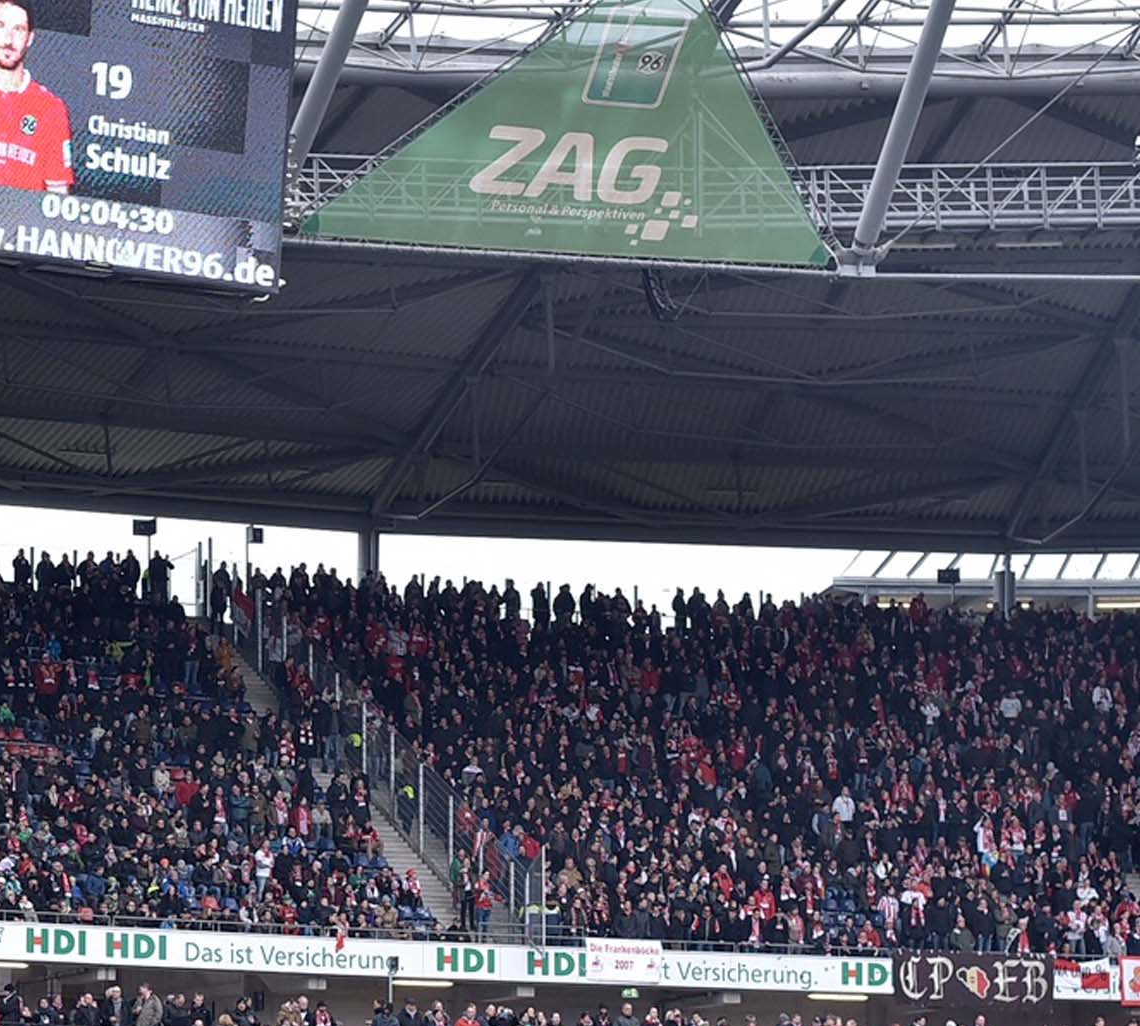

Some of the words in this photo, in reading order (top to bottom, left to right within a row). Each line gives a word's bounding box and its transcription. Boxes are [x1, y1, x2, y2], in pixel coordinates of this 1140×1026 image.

[224, 0, 284, 32] HEIDEN
[637, 53, 666, 73] 96
[91, 61, 133, 99] 19
[88, 114, 170, 146] Christian
[85, 148, 171, 180] Schulz
[469, 125, 669, 205] ZAG
[42, 194, 173, 235] 00:04:30
[490, 200, 547, 215] Personal
[561, 206, 647, 221] Perspektiven
[25, 927, 86, 956] HDI
[105, 931, 167, 960] HDI
[185, 941, 222, 964] Das
[229, 942, 253, 965] ist
[436, 947, 495, 973] HDI
[527, 951, 587, 977] HDI
[677, 961, 818, 989] Versicherung.
[841, 962, 889, 987] HD
